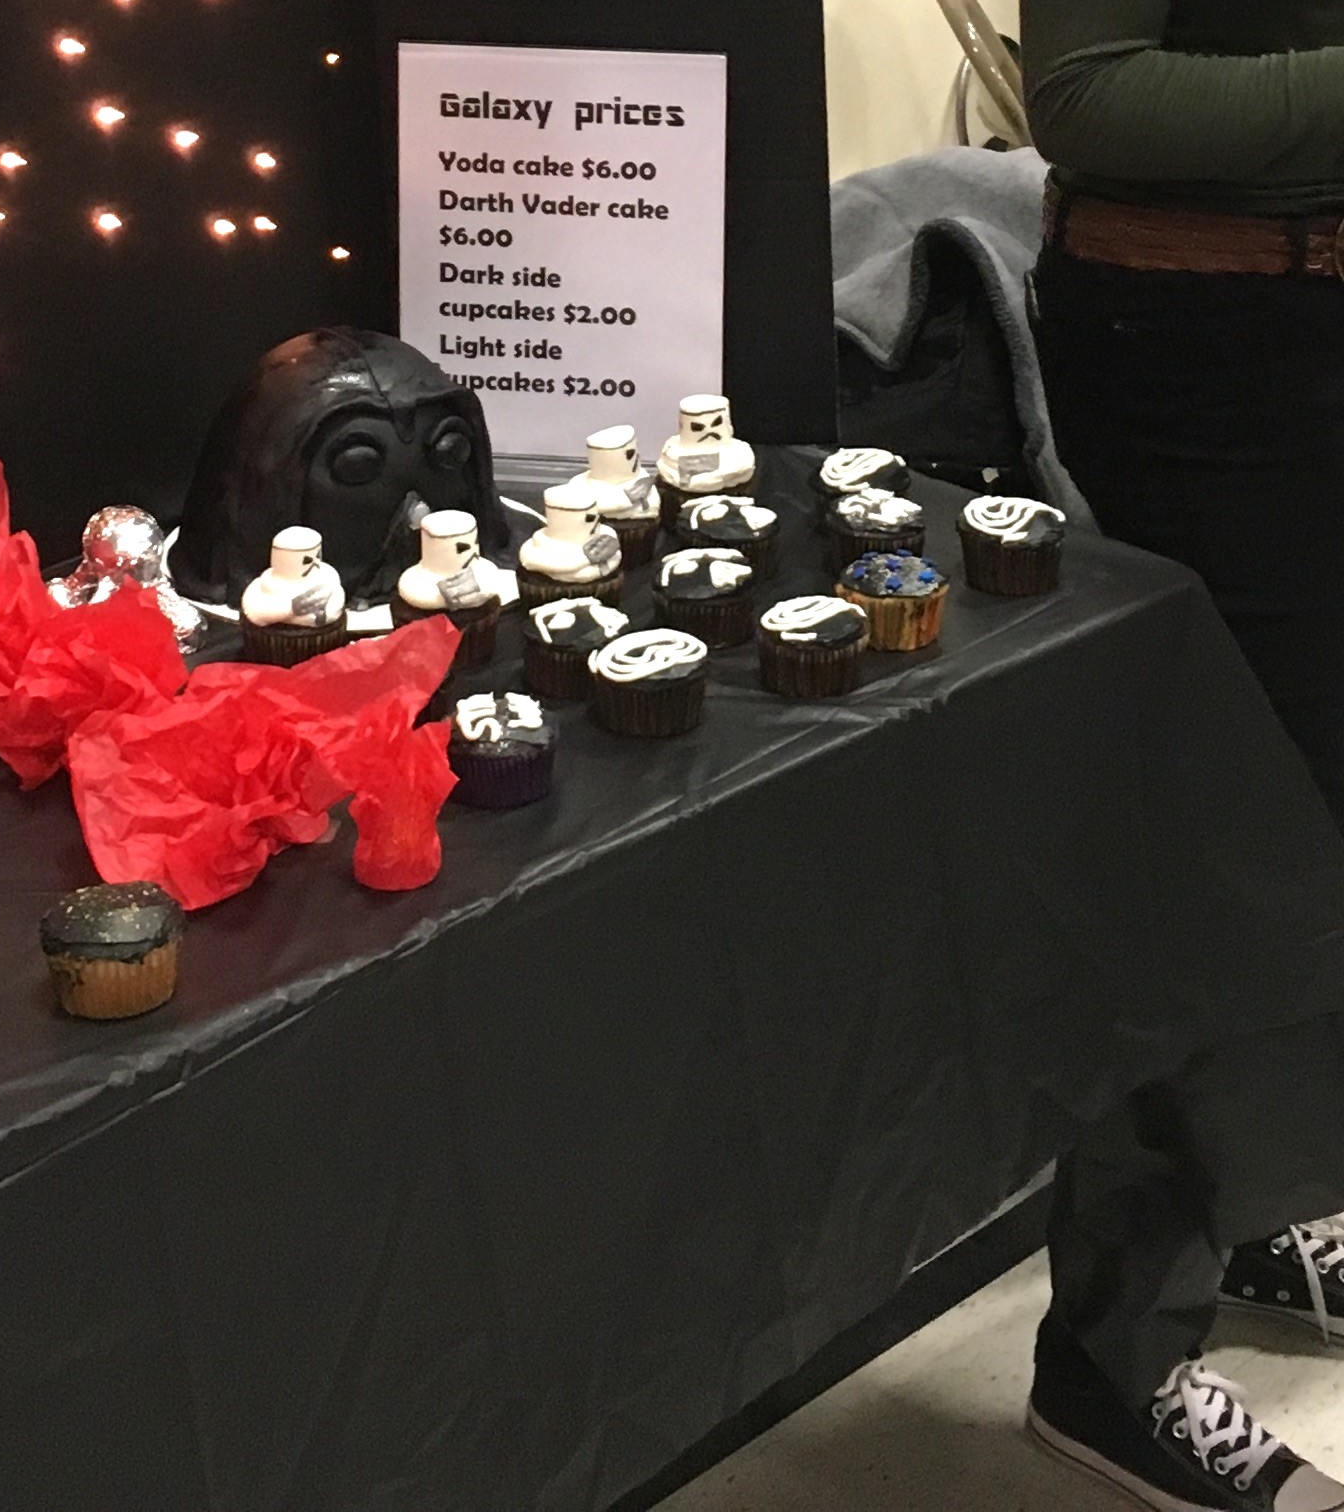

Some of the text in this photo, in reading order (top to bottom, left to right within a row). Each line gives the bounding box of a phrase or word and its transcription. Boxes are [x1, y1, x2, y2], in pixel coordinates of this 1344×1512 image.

[441, 91, 684, 130] Galaxy prices
[439, 151, 656, 180] Yoda cake $6.00
[440, 190, 668, 219] Darth Vader cake
[440, 225, 513, 247] $6.00
[440, 263, 560, 288] Dark side
[439, 300, 635, 325] cupcakes $2.00
[440, 334, 562, 360] Light side
[449, 371, 635, 397] upcakes $2.00
